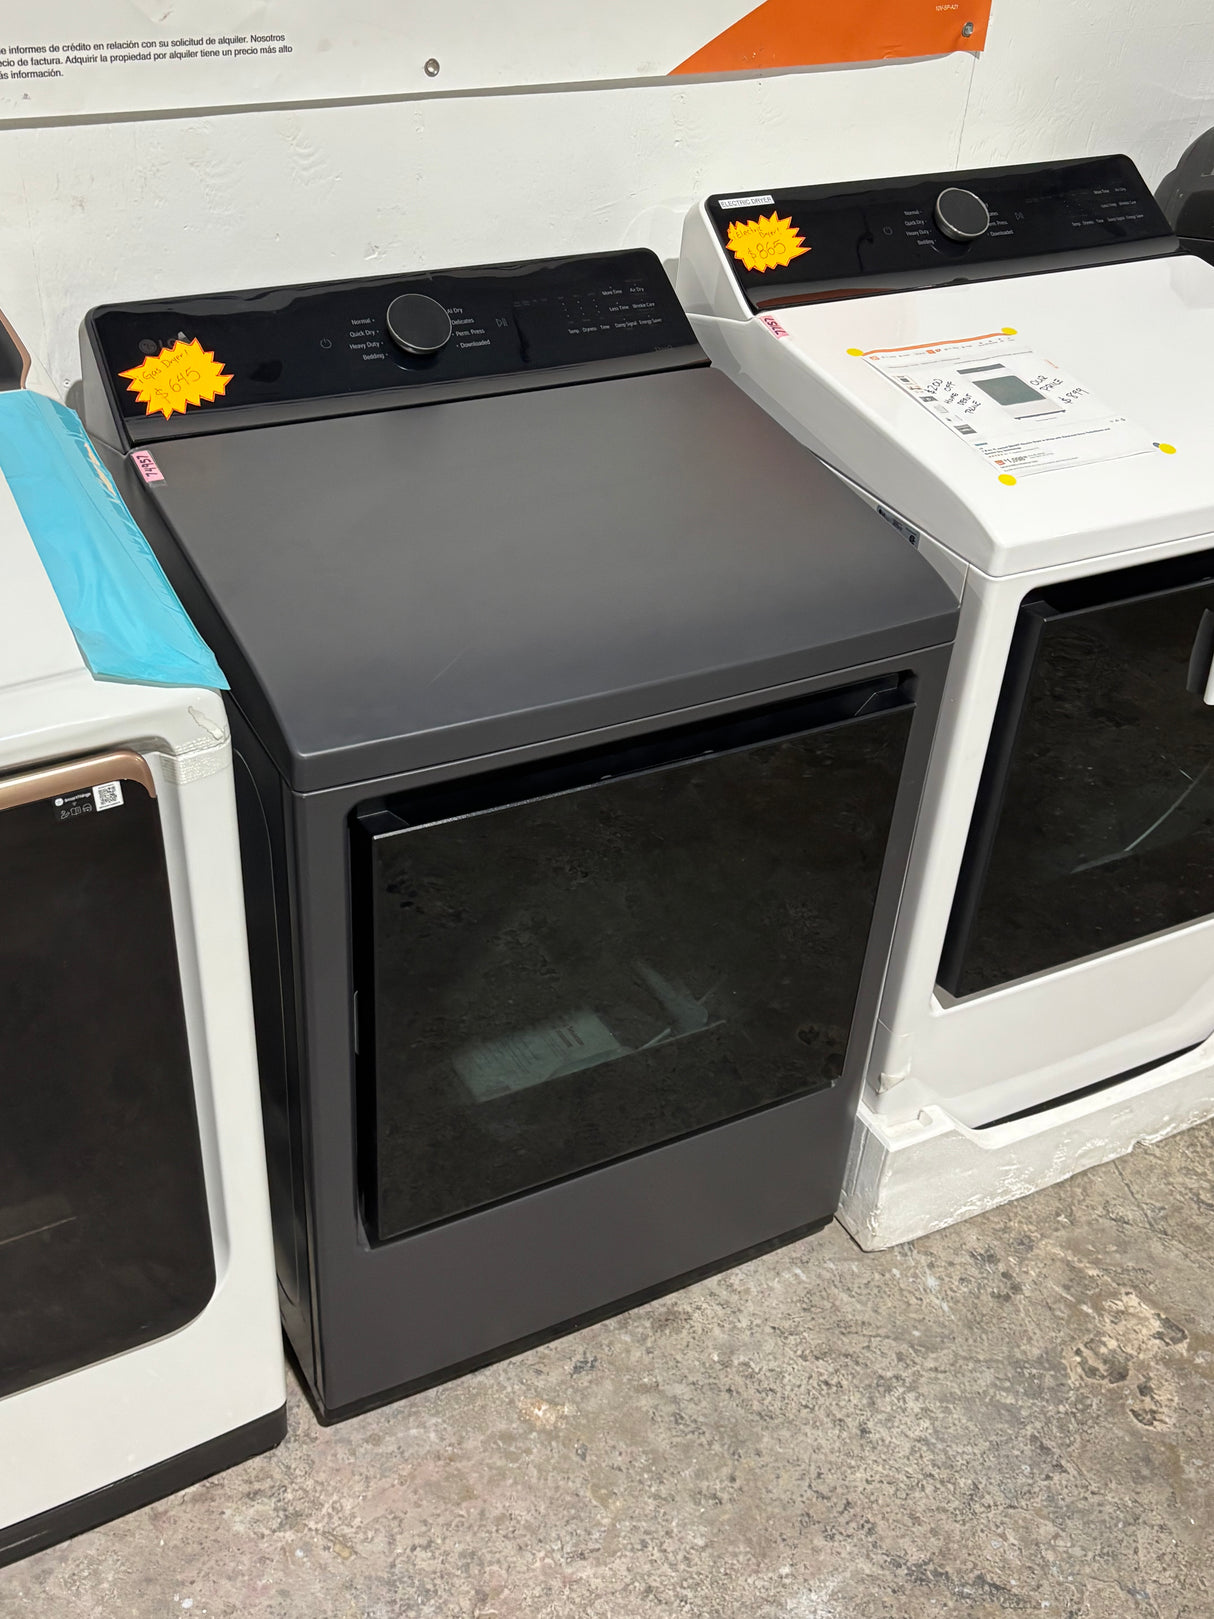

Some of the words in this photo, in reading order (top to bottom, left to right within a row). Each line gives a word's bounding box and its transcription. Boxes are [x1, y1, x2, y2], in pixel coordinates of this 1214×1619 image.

[8, 45, 46, 54] informes
[49, 44, 60, 53] de
[62, 42, 91, 52] crédito
[106, 40, 140, 50] relación
[141, 40, 156, 48] con
[170, 37, 204, 46] solicitud
[206, 36, 216, 45] de
[218, 36, 248, 46] alquiler.
[250, 34, 286, 42] Nosotros
[18, 58, 28, 66] de
[31, 56, 63, 66] factura.
[65, 54, 98, 66] Adquirir
[100, 54, 108, 62] la
[110, 52, 152, 63] propiedad
[154, 52, 167, 62] por
[169, 50, 198, 60] alquiler
[200, 49, 220, 57] tiene
[234, 46, 258, 58] precio
[260, 46, 276, 54] más
[278, 45, 293, 53] alto
[11, 69, 64, 79] información.
[720, 199, 750, 208] ELECTRIC
[750, 196, 772, 205] DRYER
[748, 239, 786, 263] $865
[460, 339, 490, 348] Downloaded
[1030, 375, 1048, 386] OUR
[136, 454, 158, 478] 74957
